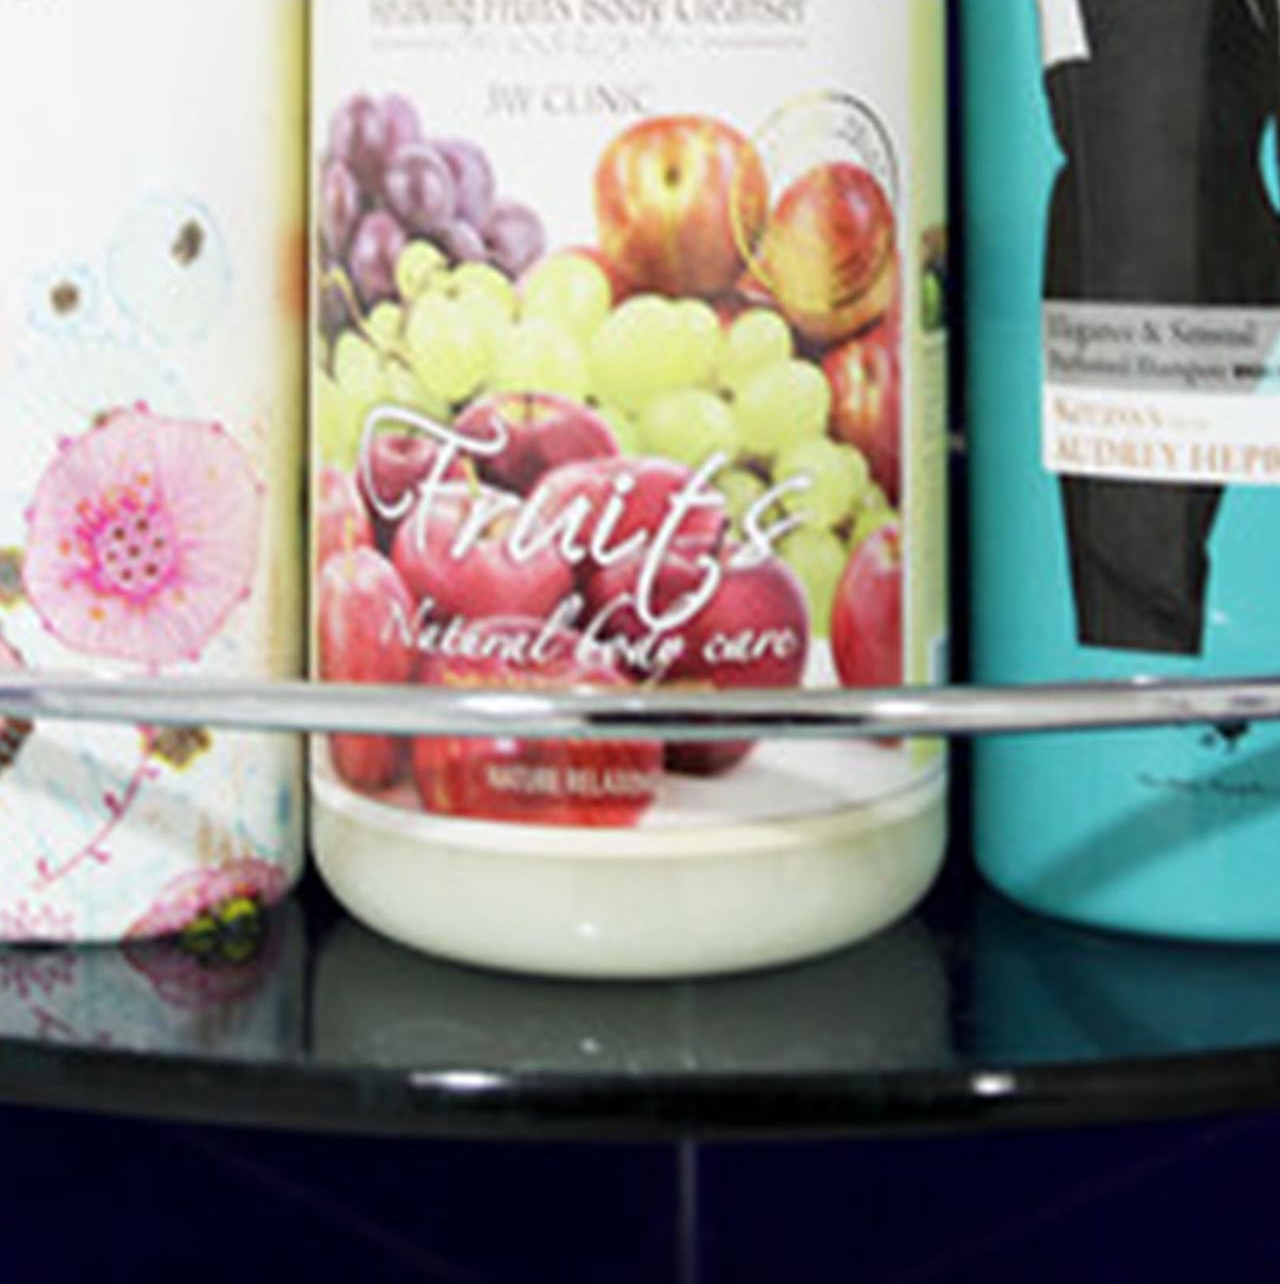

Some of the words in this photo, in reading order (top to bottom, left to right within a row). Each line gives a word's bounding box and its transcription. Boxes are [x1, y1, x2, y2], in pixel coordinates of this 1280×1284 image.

[358, 402, 814, 630] Fruits
[378, 590, 584, 668] Natural
[571, 590, 688, 694] body
[701, 624, 800, 666] care
